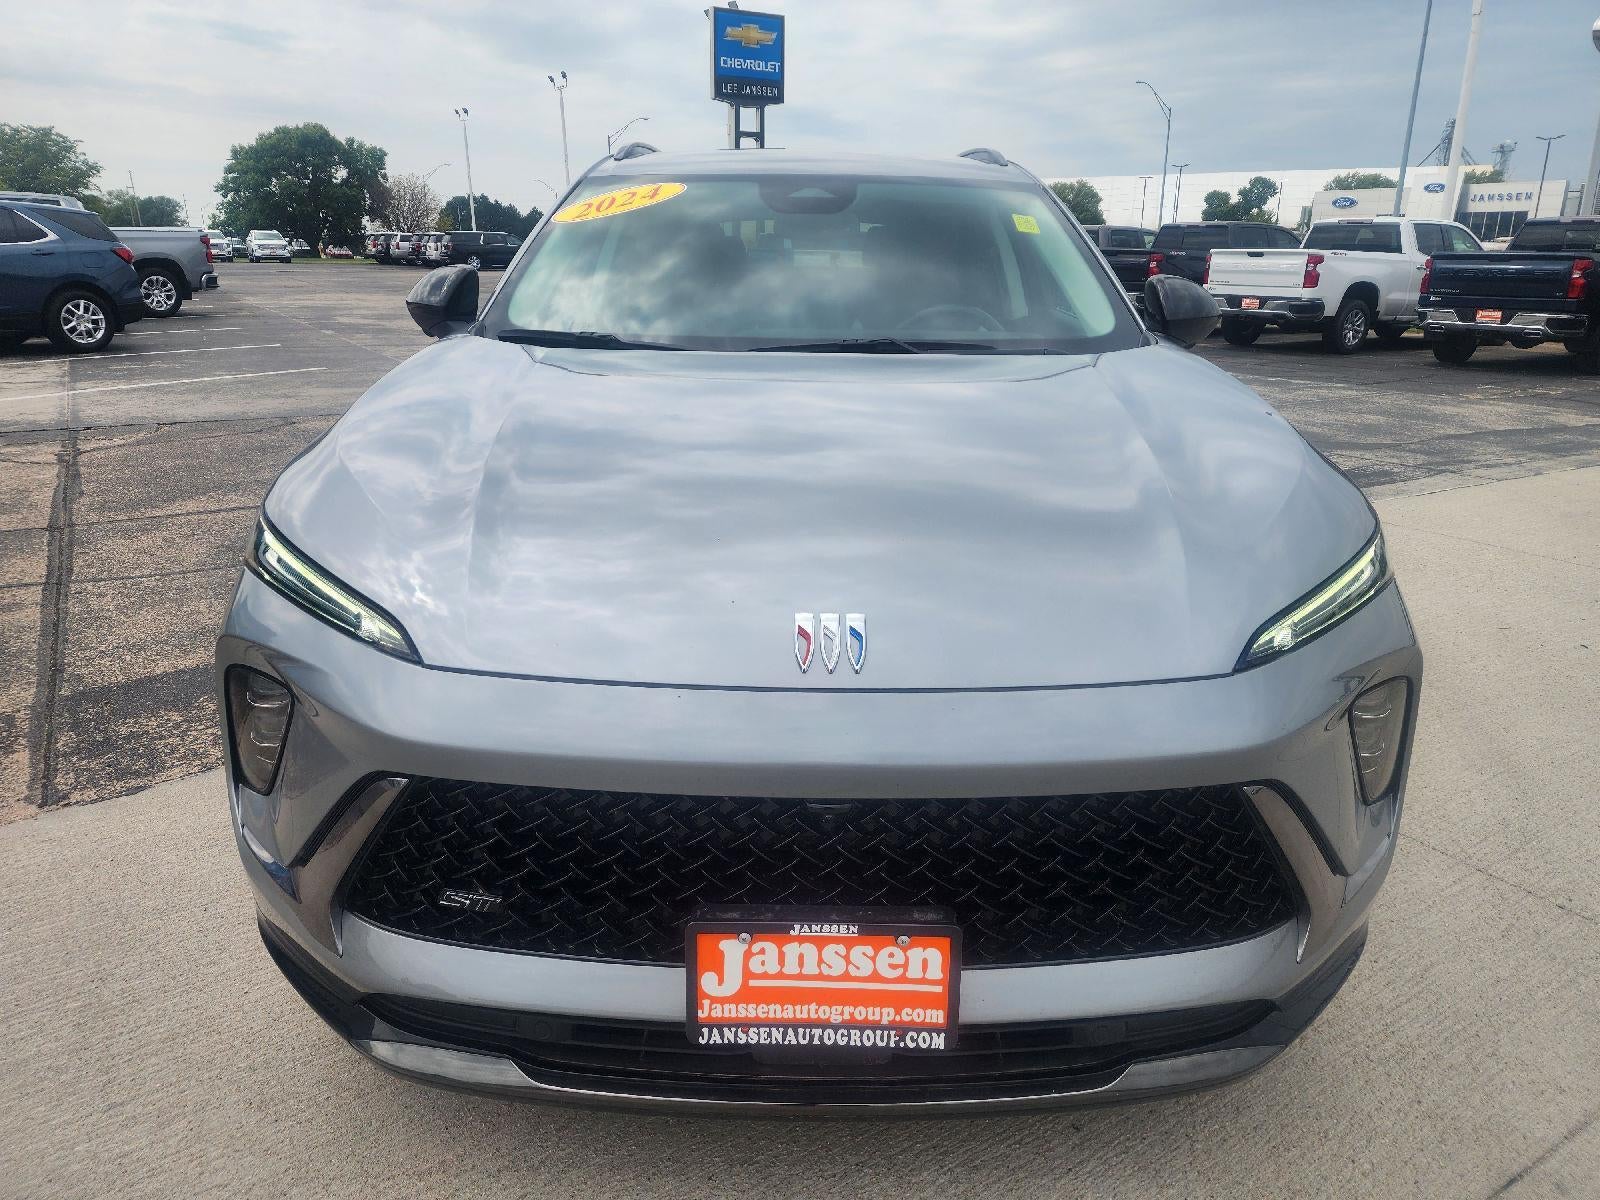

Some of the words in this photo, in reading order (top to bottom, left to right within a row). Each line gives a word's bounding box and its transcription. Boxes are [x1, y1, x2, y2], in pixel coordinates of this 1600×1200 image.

[720, 57, 780, 72] CHEVROLET
[722, 83, 738, 93] LEE
[742, 85, 778, 96] JANSSEN
[572, 184, 662, 219] 2024
[1334, 197, 1354, 207] Ford
[1470, 192, 1533, 202] JANSSEN
[790, 924, 859, 936] JANSSEN
[700, 939, 944, 997] Janssen
[698, 999, 945, 1024] Janssenautogroup.com
[698, 1027, 946, 1049] JANSSENAUTOGROUP.COM
